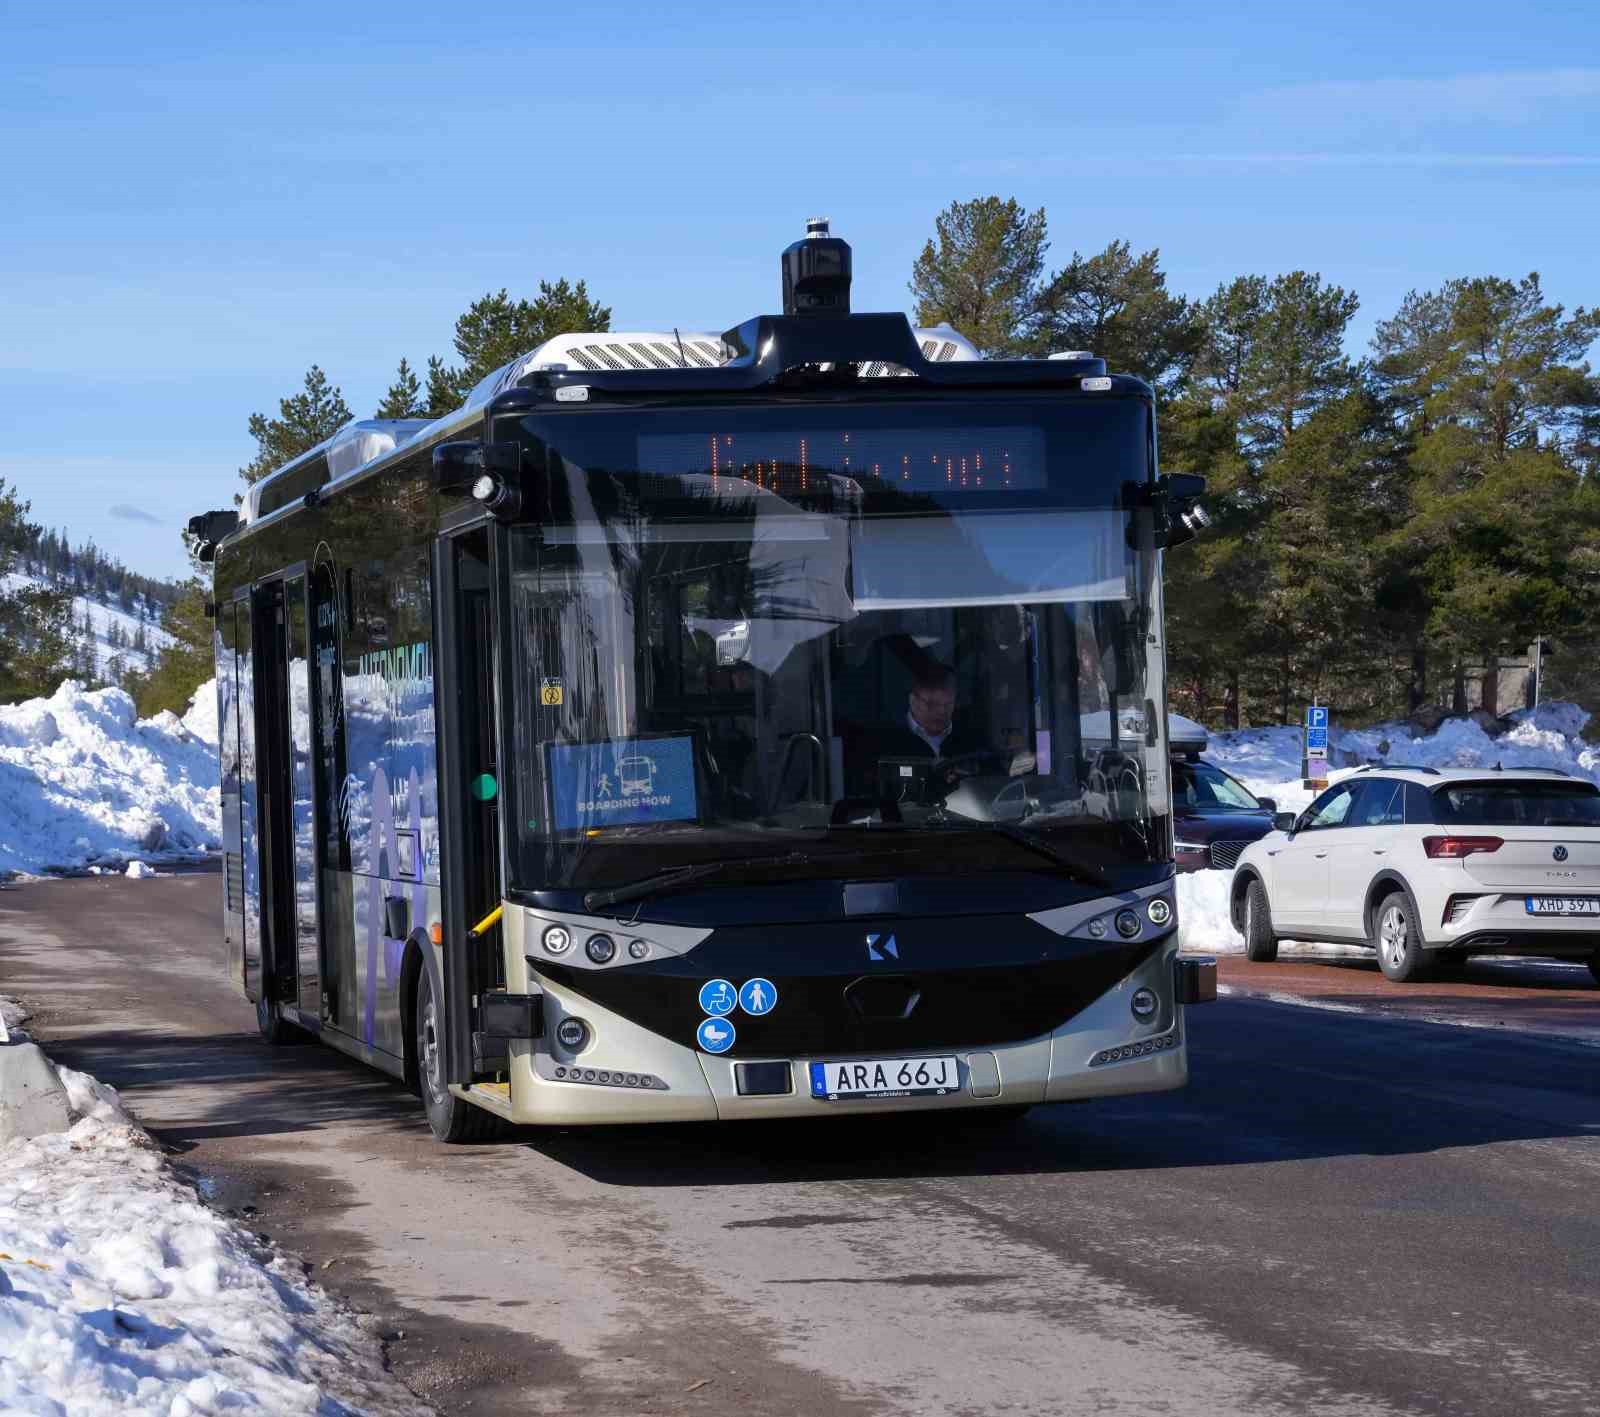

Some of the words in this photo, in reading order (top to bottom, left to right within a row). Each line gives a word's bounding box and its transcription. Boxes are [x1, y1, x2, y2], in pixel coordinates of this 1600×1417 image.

[1313, 709, 1324, 726] P
[577, 799, 641, 812] BOARDING
[642, 795, 671, 806] NOW
[1538, 898, 1564, 911] XHD
[837, 1064, 888, 1090] ARA
[897, 1061, 947, 1087] 66J
